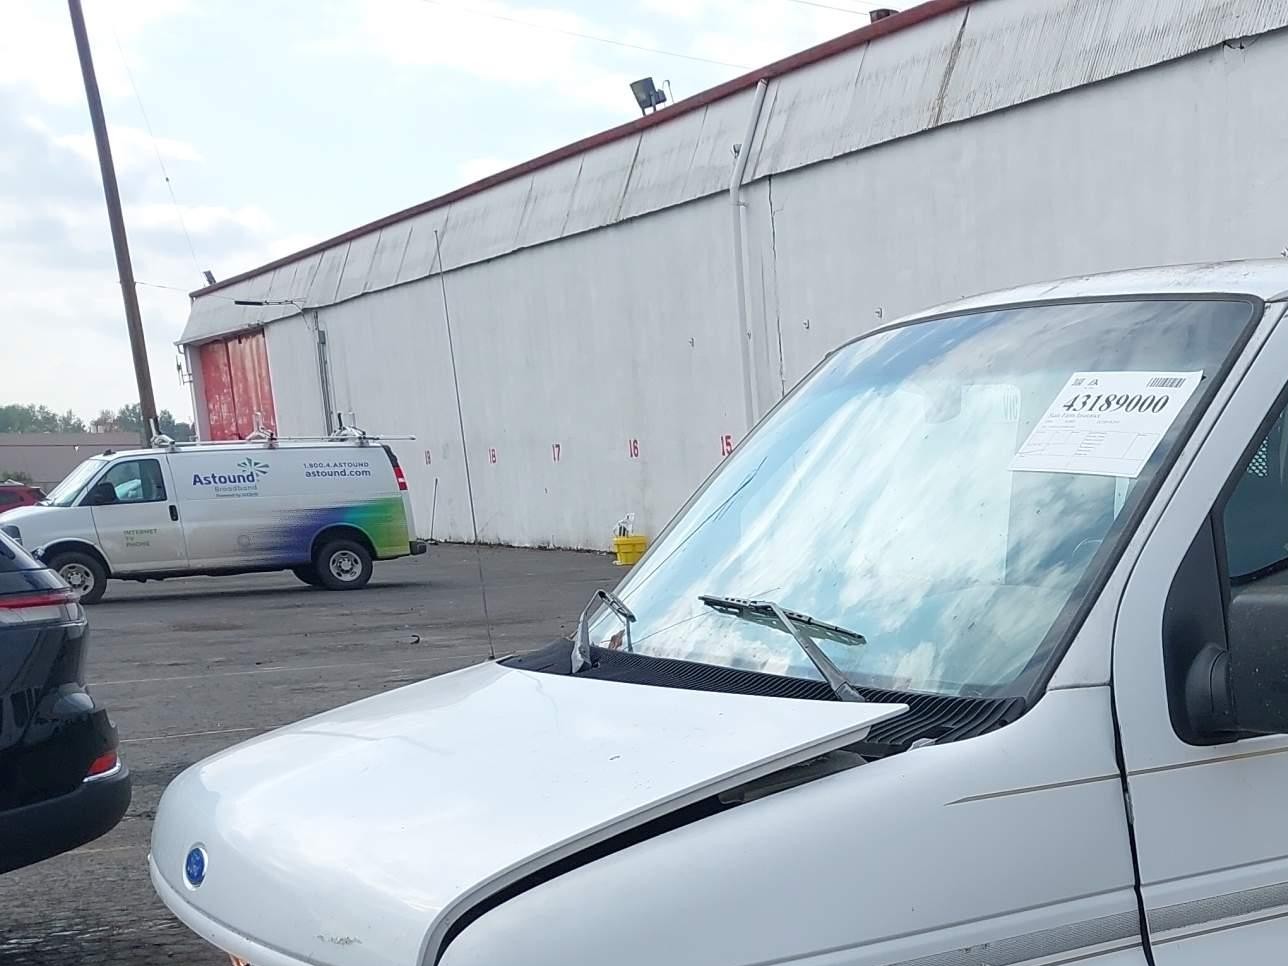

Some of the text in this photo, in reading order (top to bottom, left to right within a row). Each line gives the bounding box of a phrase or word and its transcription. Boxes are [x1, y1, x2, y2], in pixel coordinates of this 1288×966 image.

[1062, 393, 1170, 414] 43189000
[552, 443, 561, 462] 17
[629, 439, 639, 458] 16
[720, 434, 733, 457] 15
[488, 447, 497, 464] 18
[192, 471, 256, 487] Astound
[305, 468, 371, 478] astound.com
[214, 484, 258, 493] Broadband
